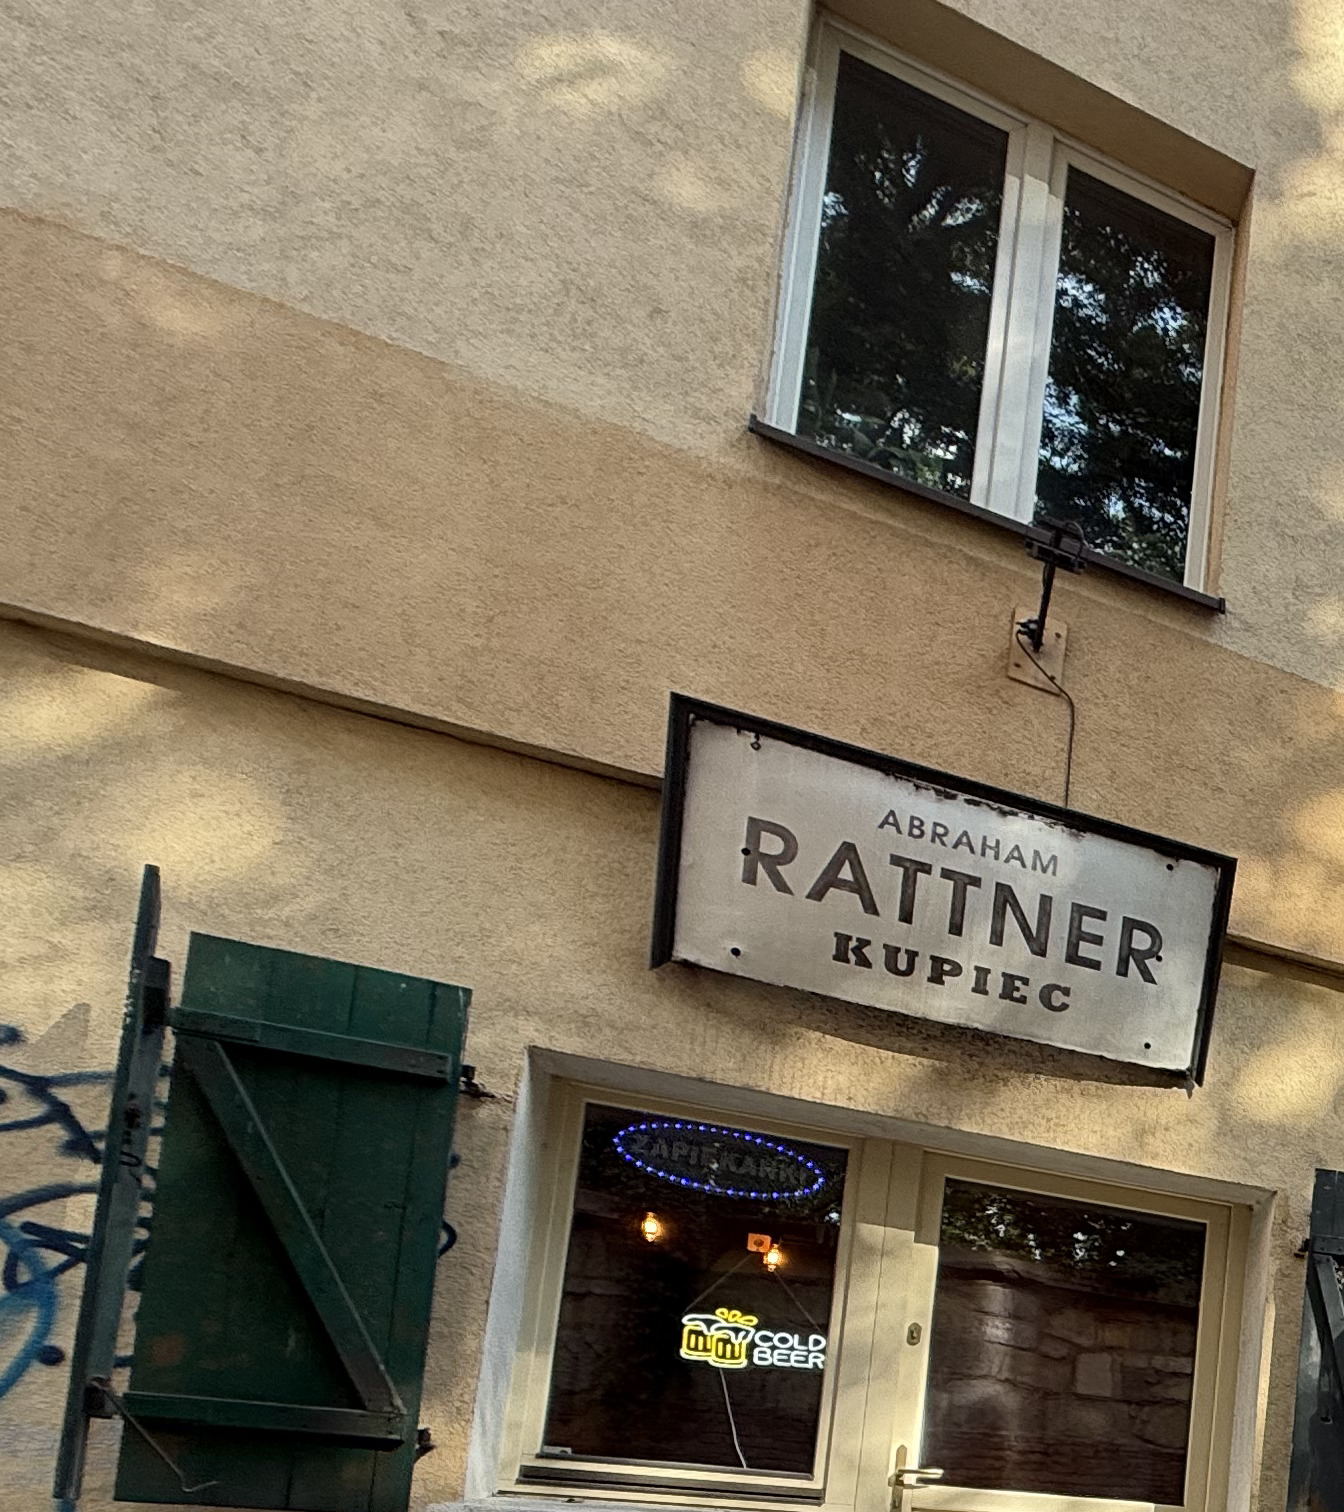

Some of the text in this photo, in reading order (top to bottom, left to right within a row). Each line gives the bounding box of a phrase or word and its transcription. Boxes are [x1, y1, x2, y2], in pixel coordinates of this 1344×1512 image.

[878, 809, 1058, 876] ABRAHAM
[741, 816, 1163, 985] RATTNER
[832, 932, 1071, 1013] KUPIEC
[752, 1347, 826, 1369] BEER
[753, 1330, 827, 1351] COLD
